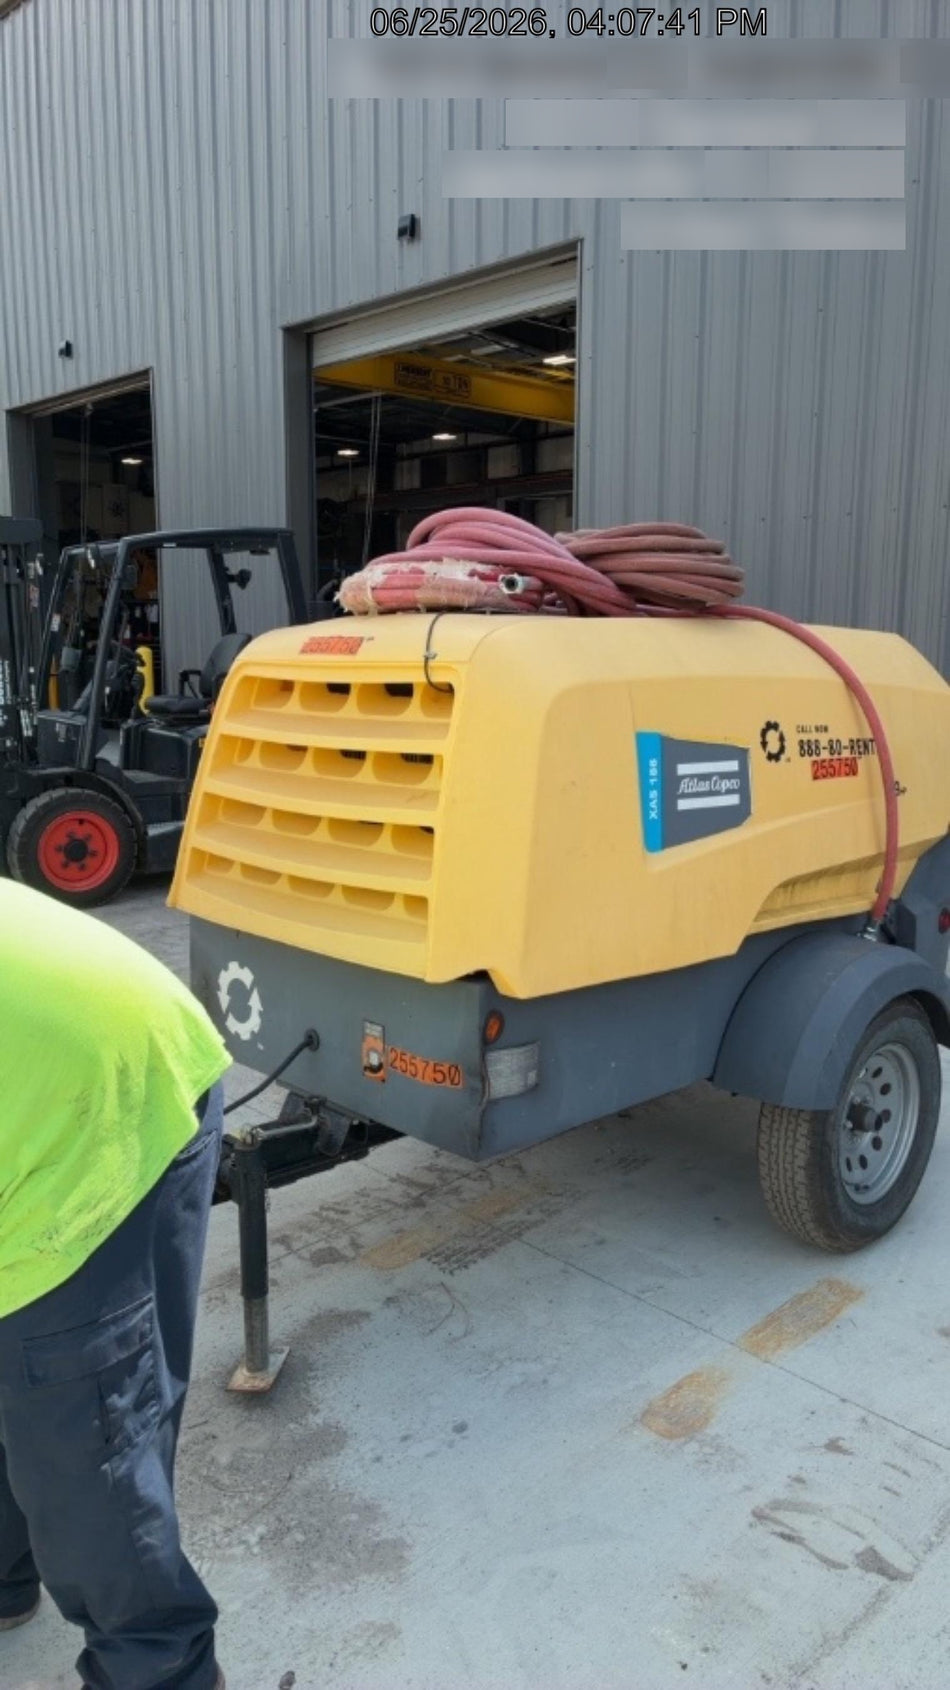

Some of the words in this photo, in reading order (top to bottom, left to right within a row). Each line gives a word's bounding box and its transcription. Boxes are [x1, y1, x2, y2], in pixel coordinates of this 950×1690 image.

[796, 725, 813, 733] CALL
[814, 725, 829, 733] NOW
[798, 738, 876, 757] 888-80-RENT
[811, 757, 858, 780] 255750
[676, 777, 710, 795] Atlas
[711, 775, 740, 793] Copco
[648, 790, 658, 820] XAS
[390, 1047, 461, 1086] 255750
